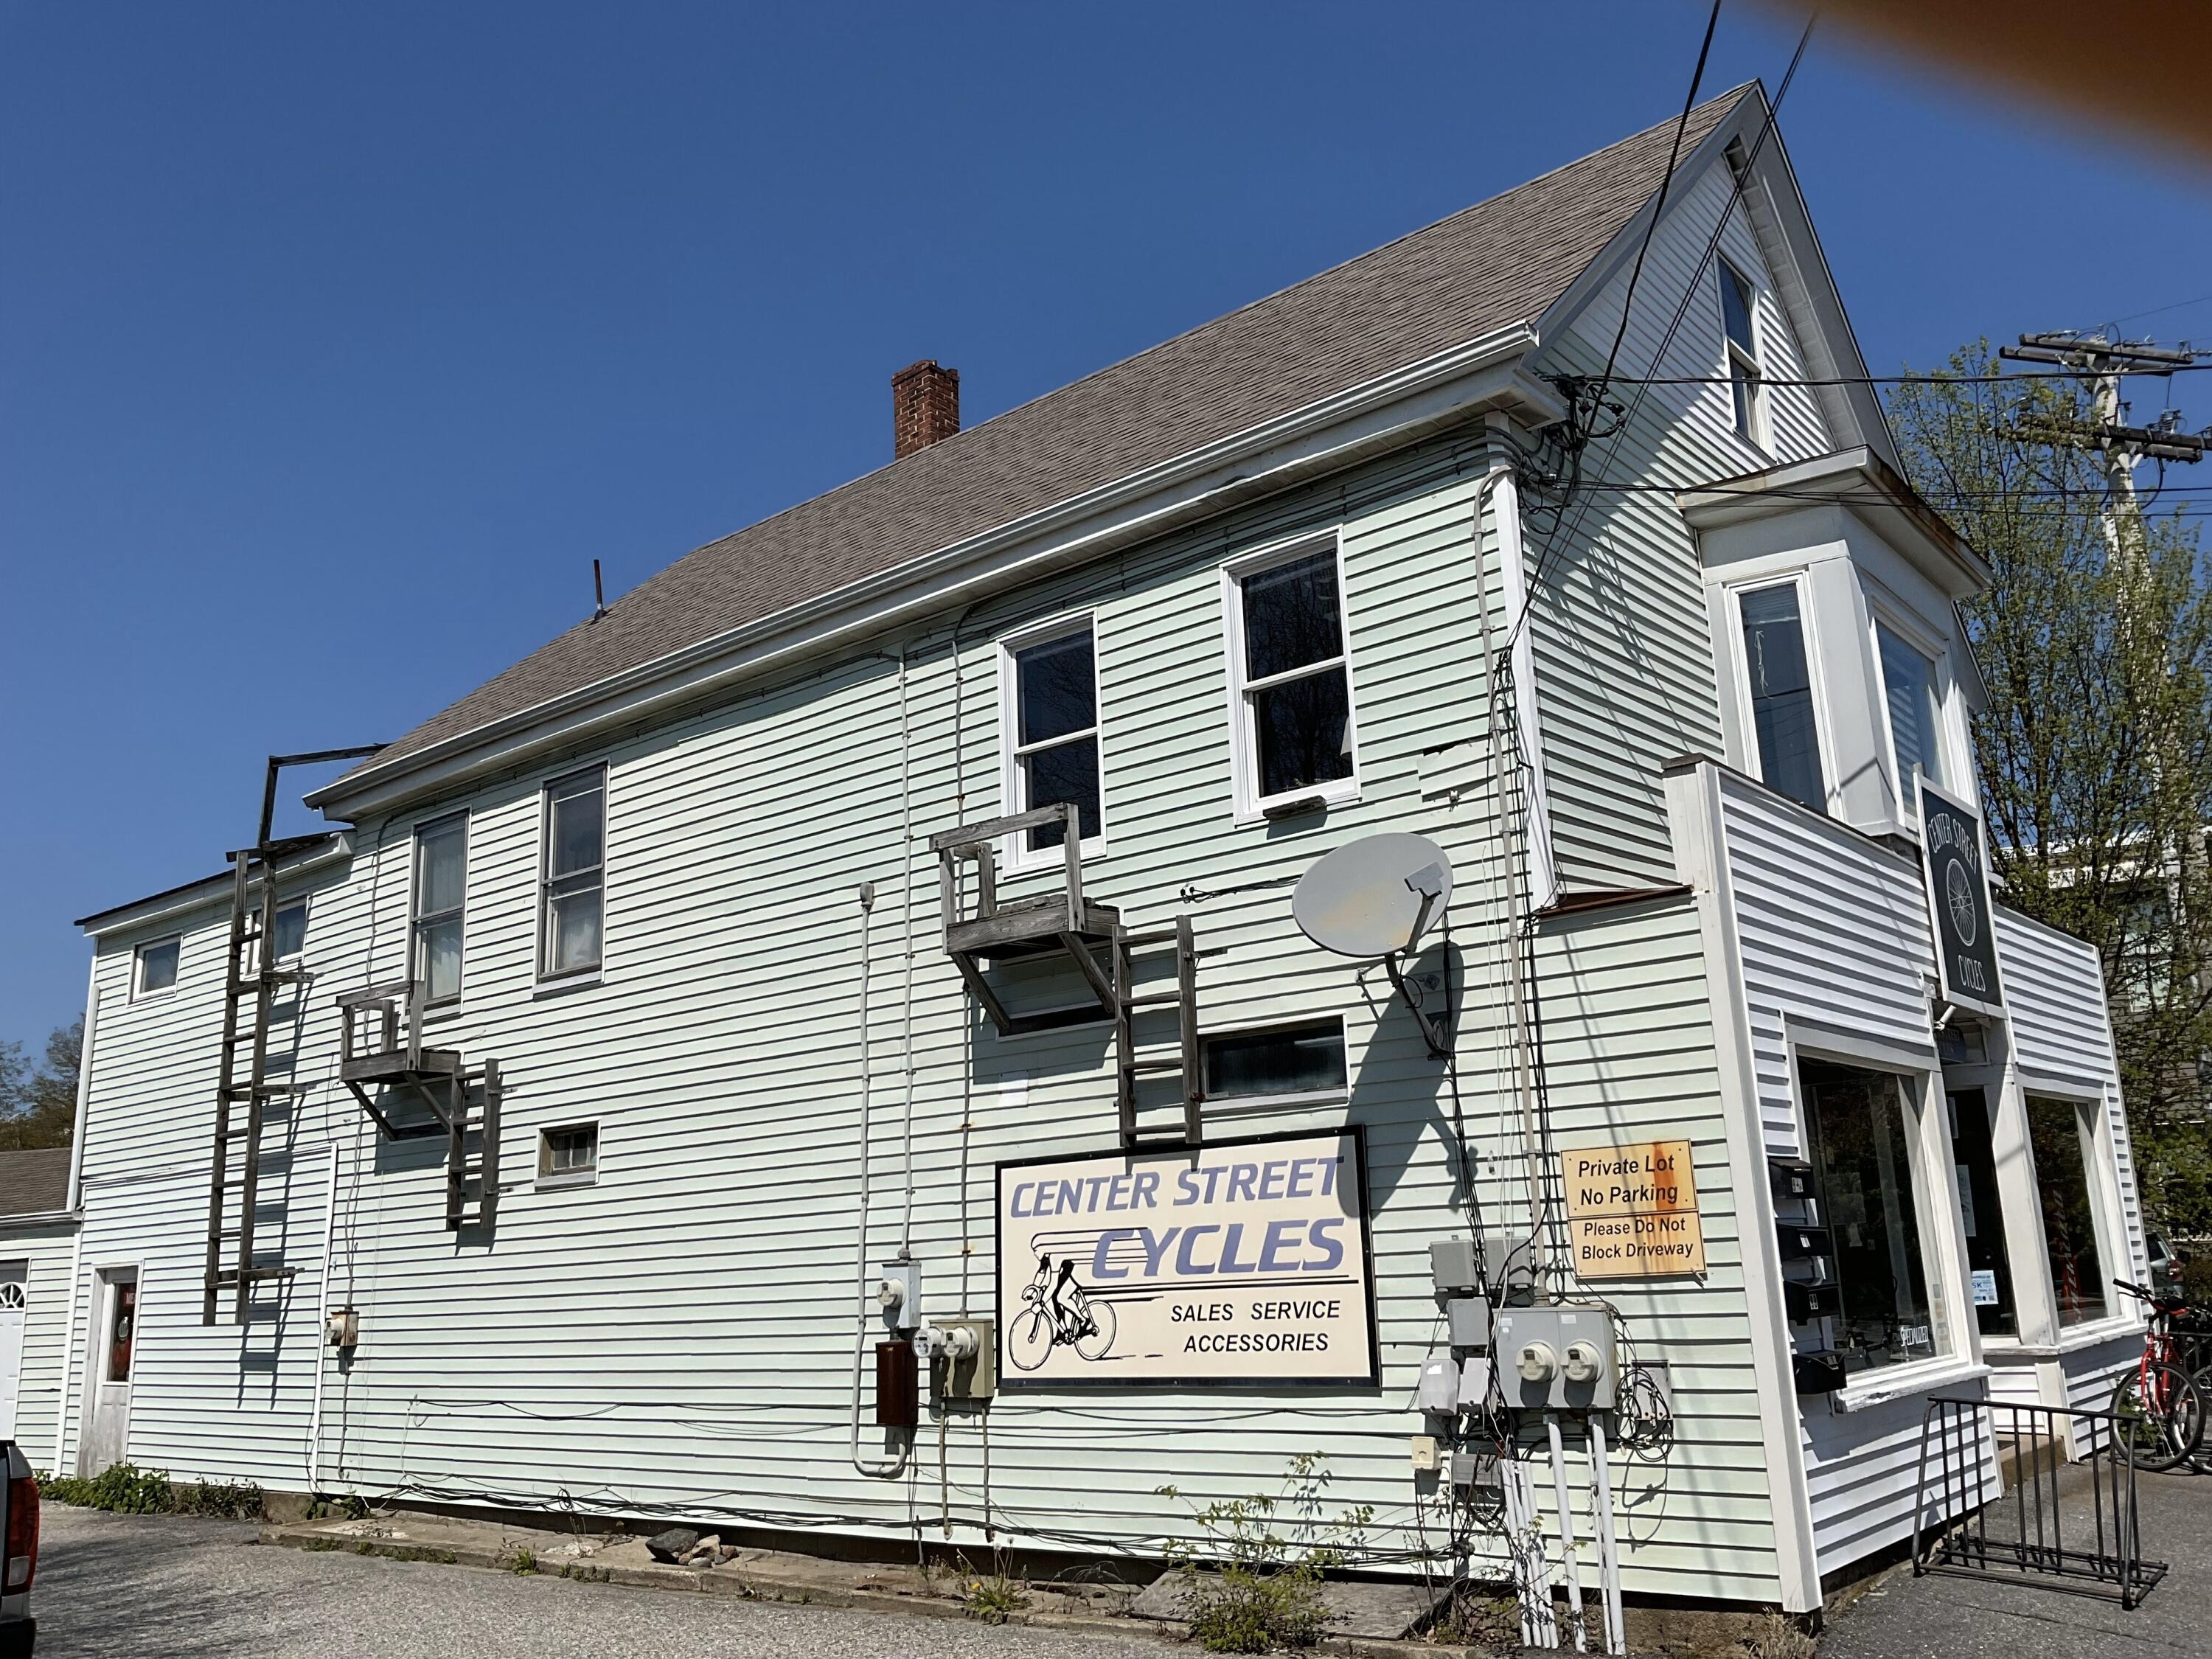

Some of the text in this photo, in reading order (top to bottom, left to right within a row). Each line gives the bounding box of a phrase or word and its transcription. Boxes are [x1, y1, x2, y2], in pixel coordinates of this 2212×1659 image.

[1928, 813, 1979, 874] CENTER STREET
[1958, 955, 1986, 992] CYCLES
[1579, 1154, 1674, 1178] Private Lot
[1010, 1155, 1345, 1218] CENTER STREET
[1580, 1183, 1677, 1205] No Parking
[1585, 1217, 1686, 1237] Please Do Not
[1091, 1217, 1345, 1279] CYCLES
[1582, 1242, 1694, 1259] Block Driveway
[1171, 1300, 1341, 1323] SALES SERVICE
[1183, 1333, 1329, 1353] ACCESSORIES
